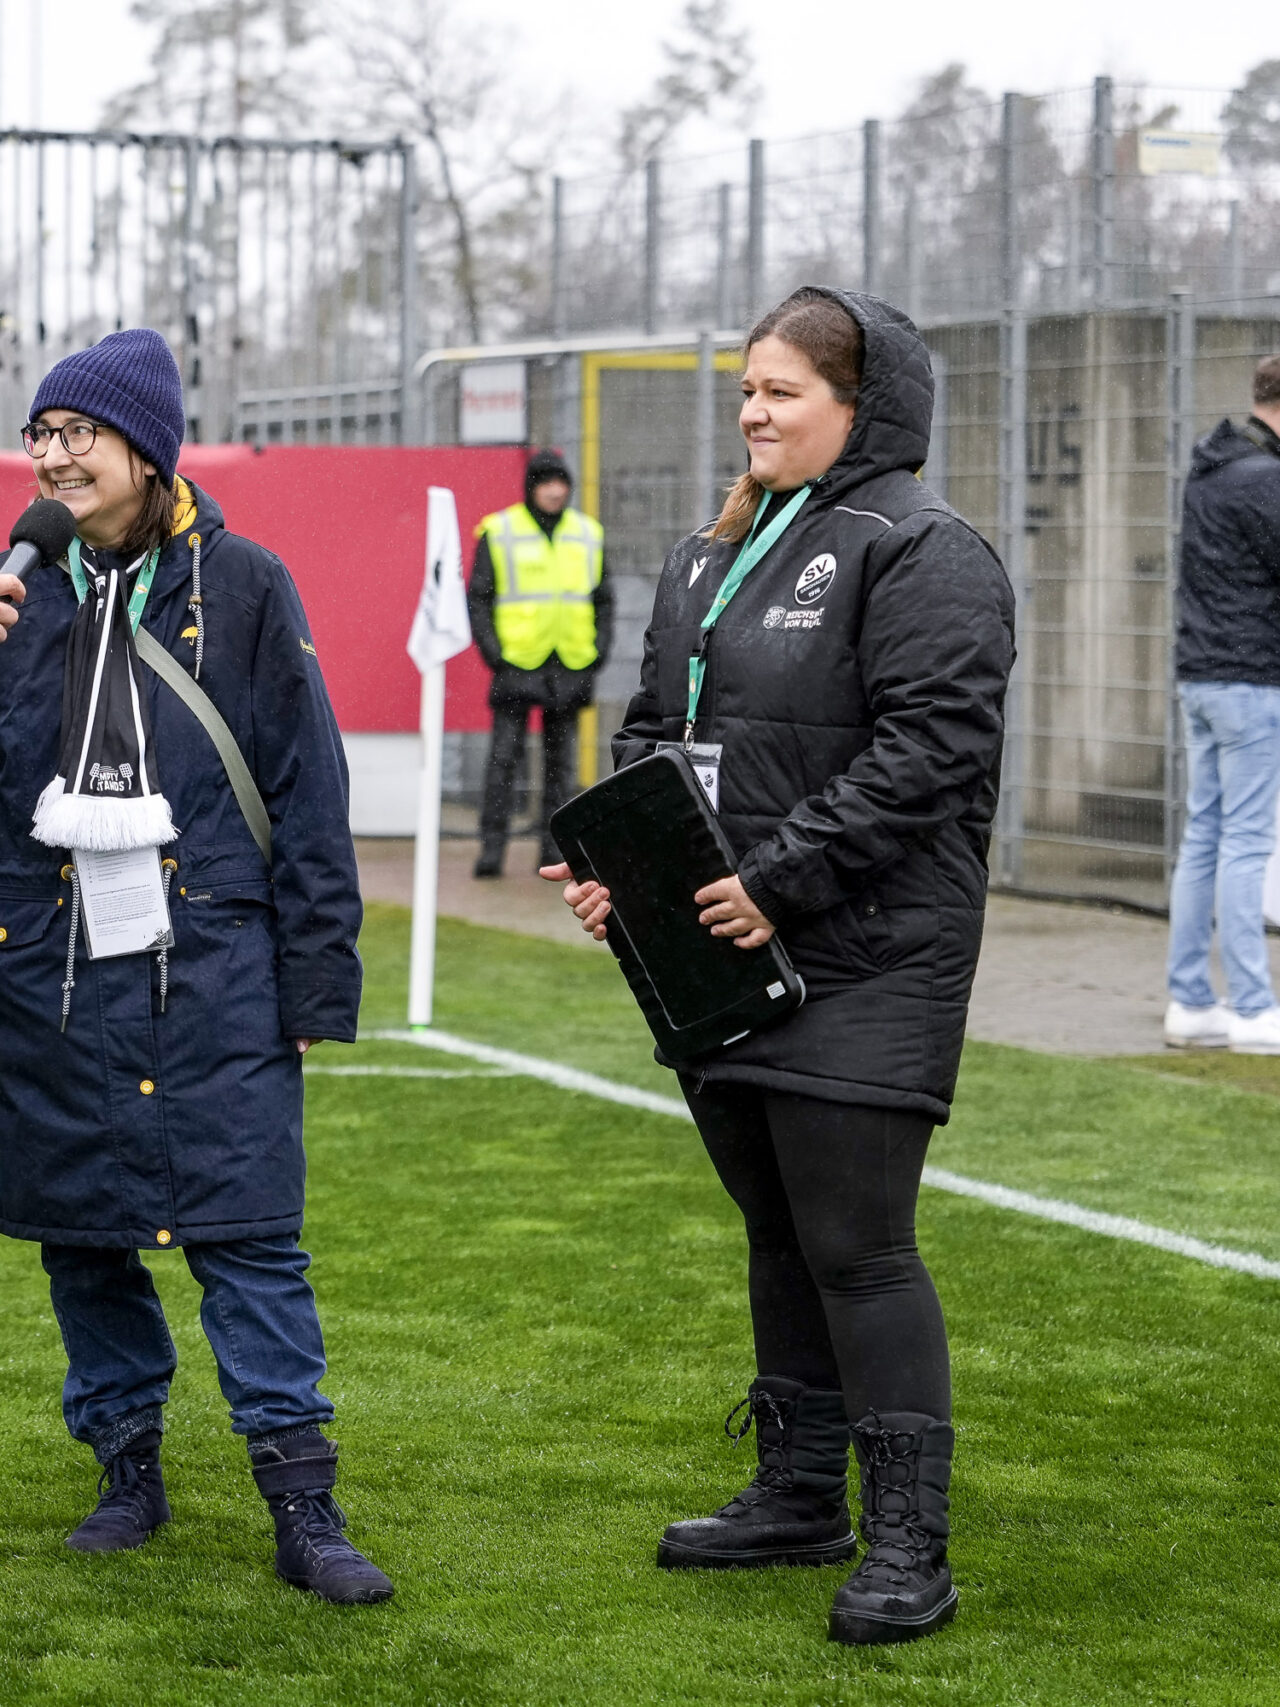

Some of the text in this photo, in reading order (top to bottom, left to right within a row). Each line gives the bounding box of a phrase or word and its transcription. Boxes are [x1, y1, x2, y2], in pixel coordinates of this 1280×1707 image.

[805, 559, 828, 581] SV
[784, 619, 801, 628] VON
[98, 772, 119, 782] MPTY
